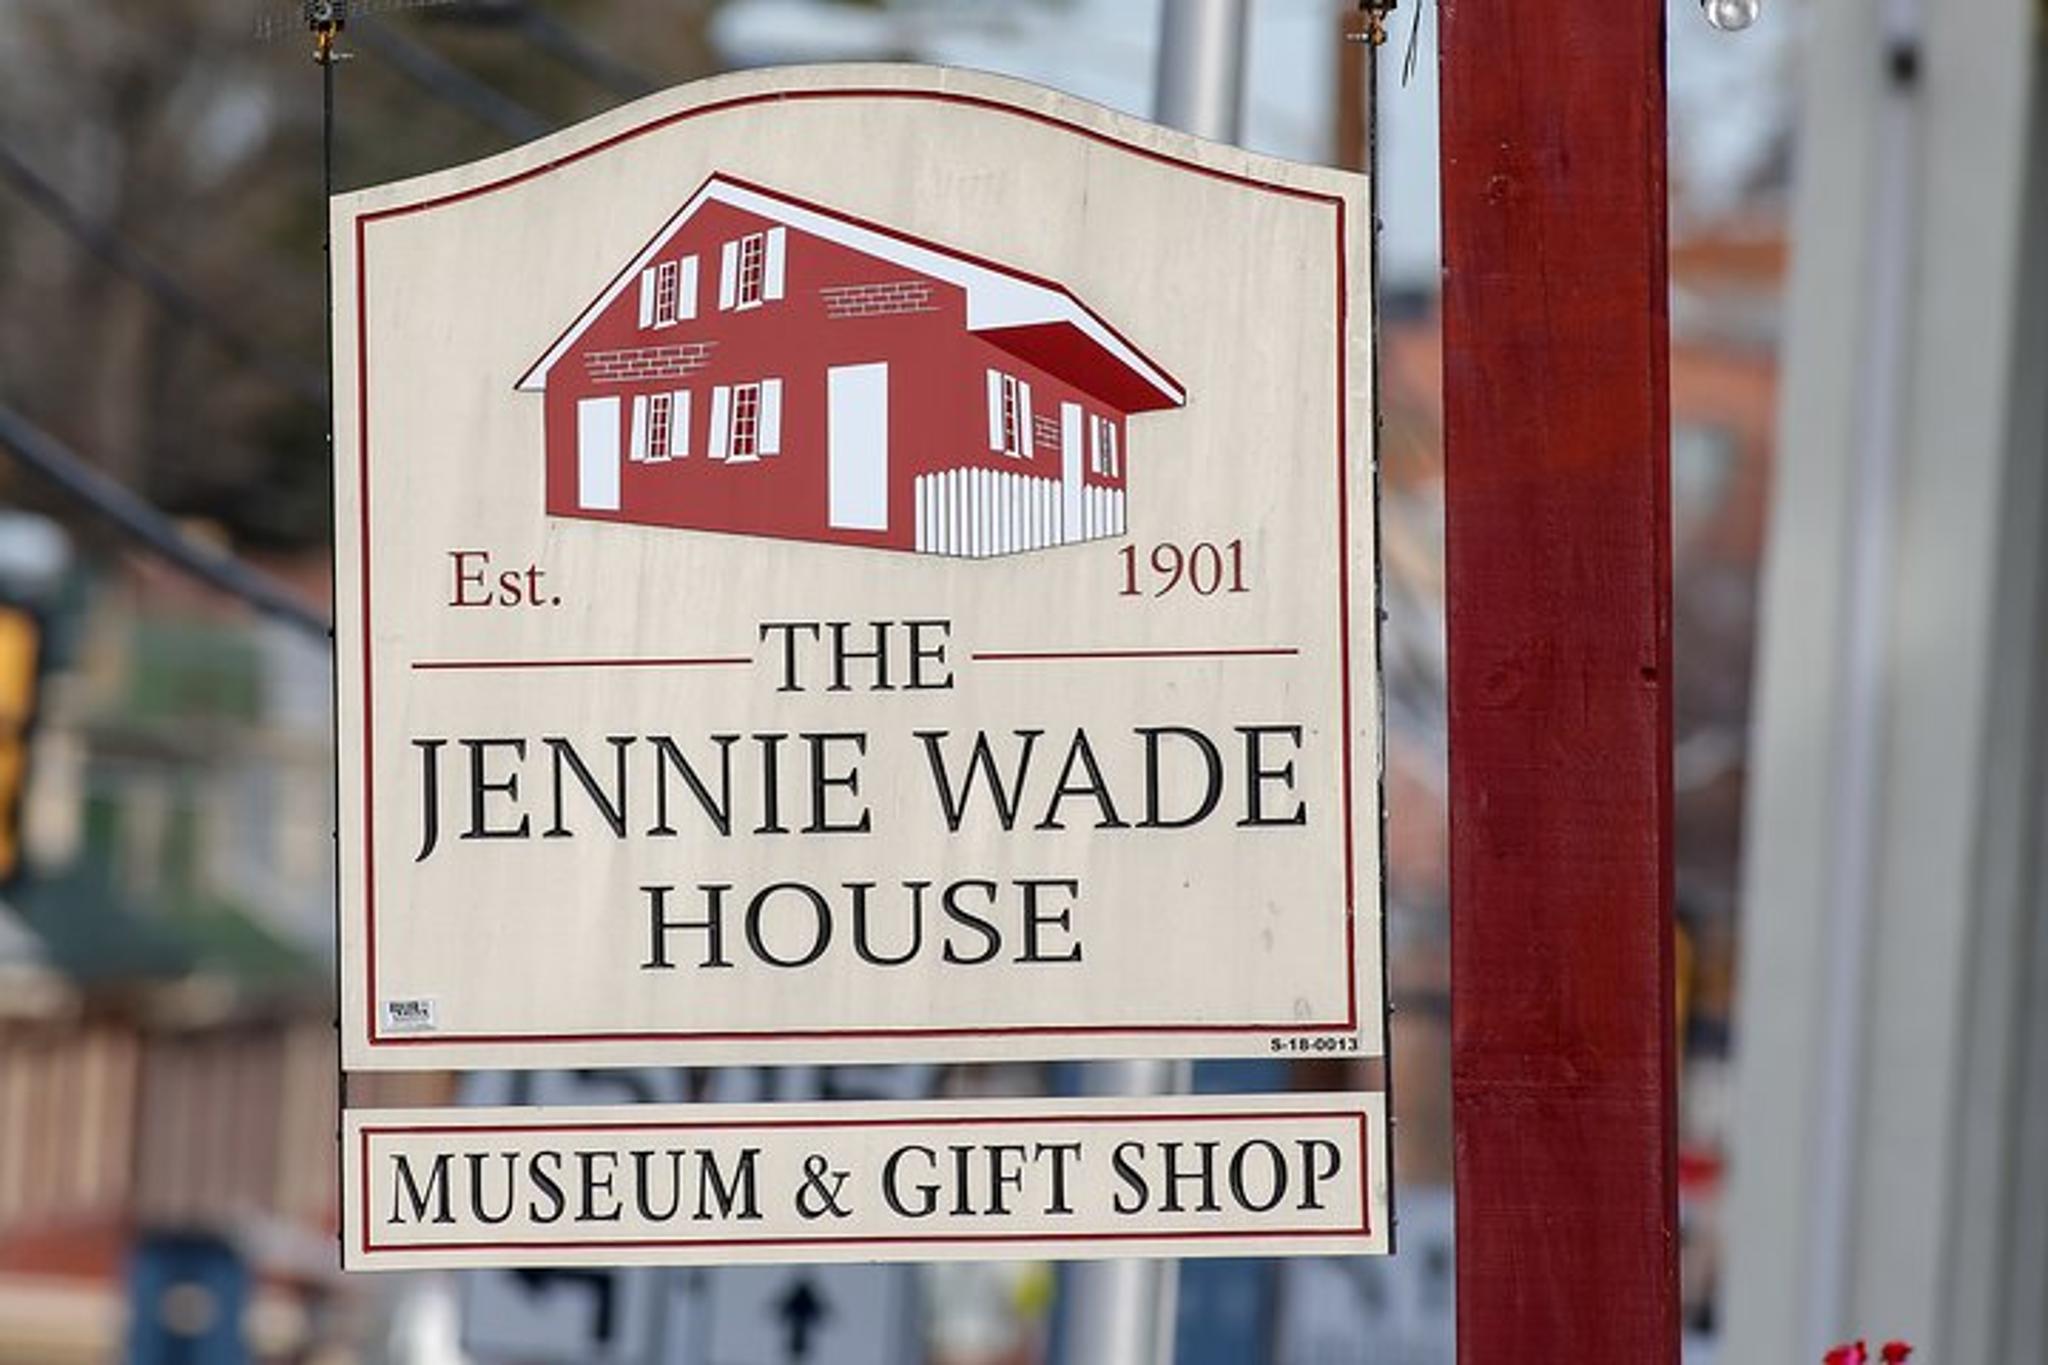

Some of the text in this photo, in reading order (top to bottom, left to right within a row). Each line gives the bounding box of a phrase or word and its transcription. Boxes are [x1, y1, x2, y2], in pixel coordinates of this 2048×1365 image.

[448, 551, 561, 607] Est.
[1117, 539, 1250, 598] 1901
[759, 619, 954, 692] THE
[411, 724, 1307, 863] JENNIE WADE
[639, 878, 1083, 970] HOUSE
[387, 1139, 1341, 1225] MUSEUM & GIFT SHOP
